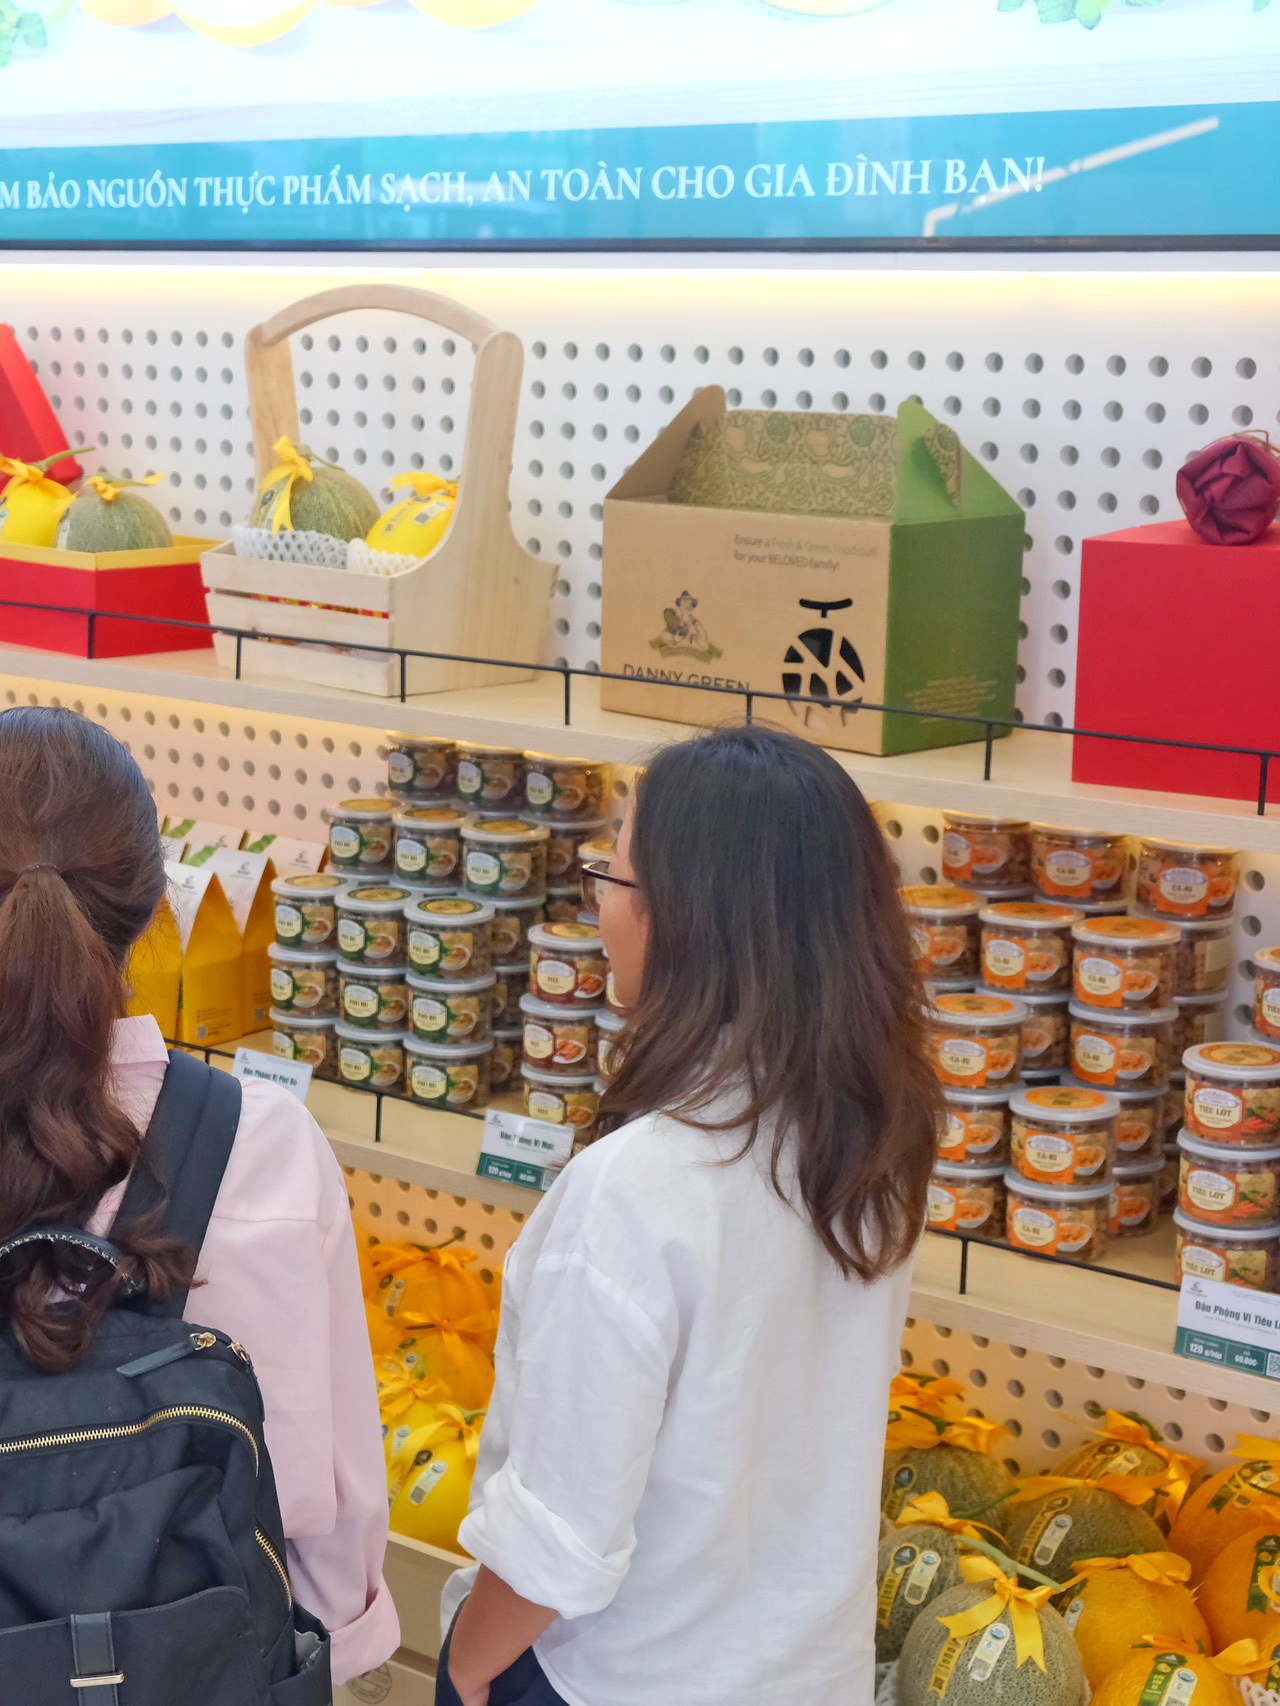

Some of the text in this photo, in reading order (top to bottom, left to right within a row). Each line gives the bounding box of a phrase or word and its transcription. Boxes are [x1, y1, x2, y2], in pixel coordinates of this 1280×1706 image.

[26, 171, 81, 209] BẢO
[194, 170, 276, 215] THỰC
[283, 164, 372, 206] PHẨM
[380, 172, 474, 213] SẠCH,
[482, 170, 533, 202] AN
[541, 160, 643, 202] TOÀN
[651, 165, 735, 201] CHO
[744, 163, 816, 199] GIA
[825, 153, 934, 198] ĐÌNH
[623, 663, 683, 683] DANNY
[1189, 1342, 1204, 1355] 120
